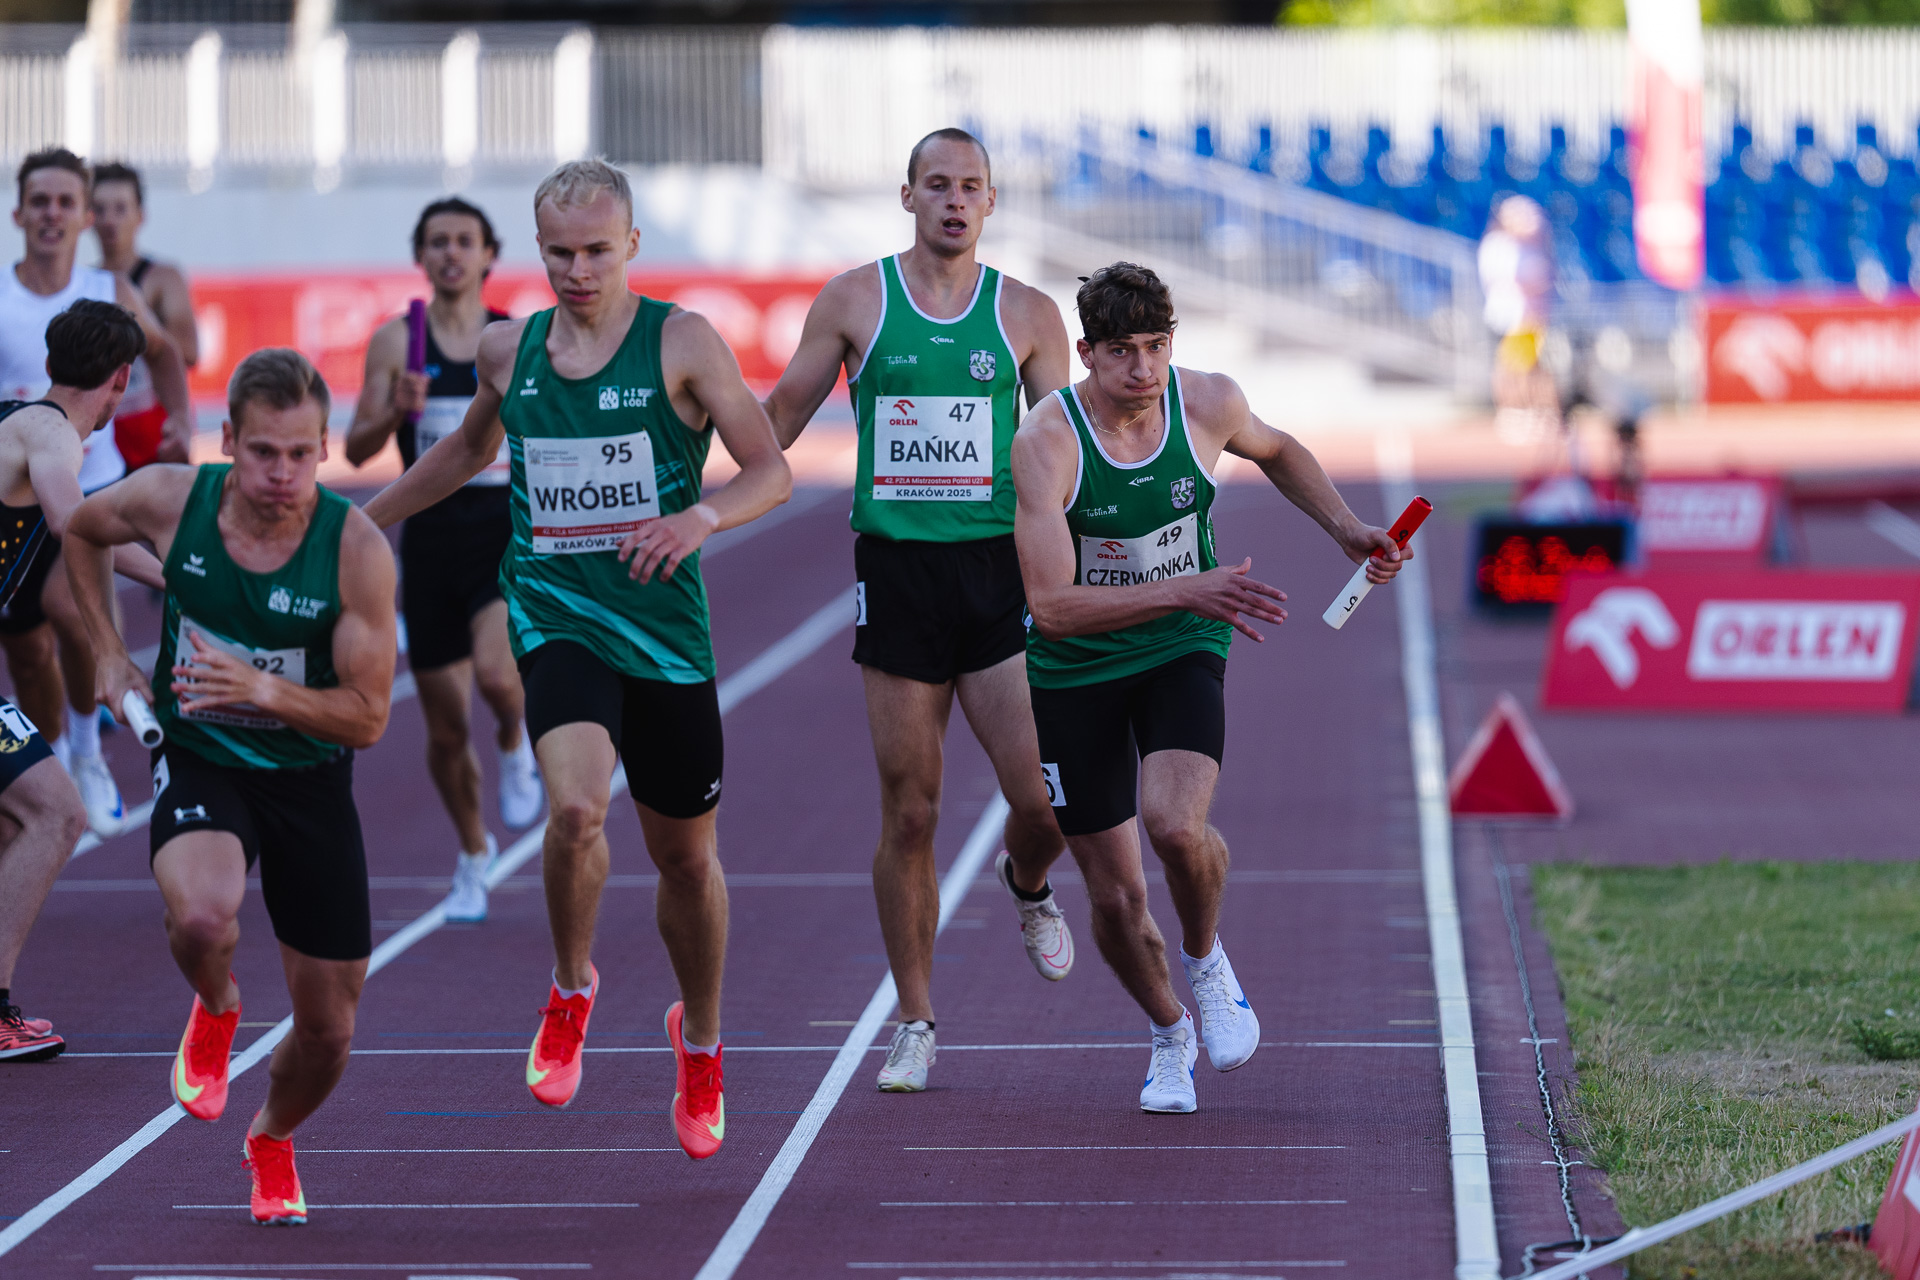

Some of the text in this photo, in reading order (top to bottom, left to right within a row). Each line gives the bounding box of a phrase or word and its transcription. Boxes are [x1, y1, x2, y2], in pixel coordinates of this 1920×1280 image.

[889, 418, 918, 426] ORLEN
[949, 402, 976, 423] 47
[601, 441, 633, 465] 95
[890, 435, 979, 463] BAŃKA
[534, 480, 651, 513] WRÓBEL
[896, 487, 972, 497] KRAKÓW 2025
[554, 537, 607, 550] KRAKÓW
[1157, 525, 1183, 548] 49
[1086, 550, 1195, 586] CZERWONKA
[1097, 553, 1128, 561] ORLEN
[1711, 622, 1881, 662] ORLEN
[253, 656, 284, 675] 92
